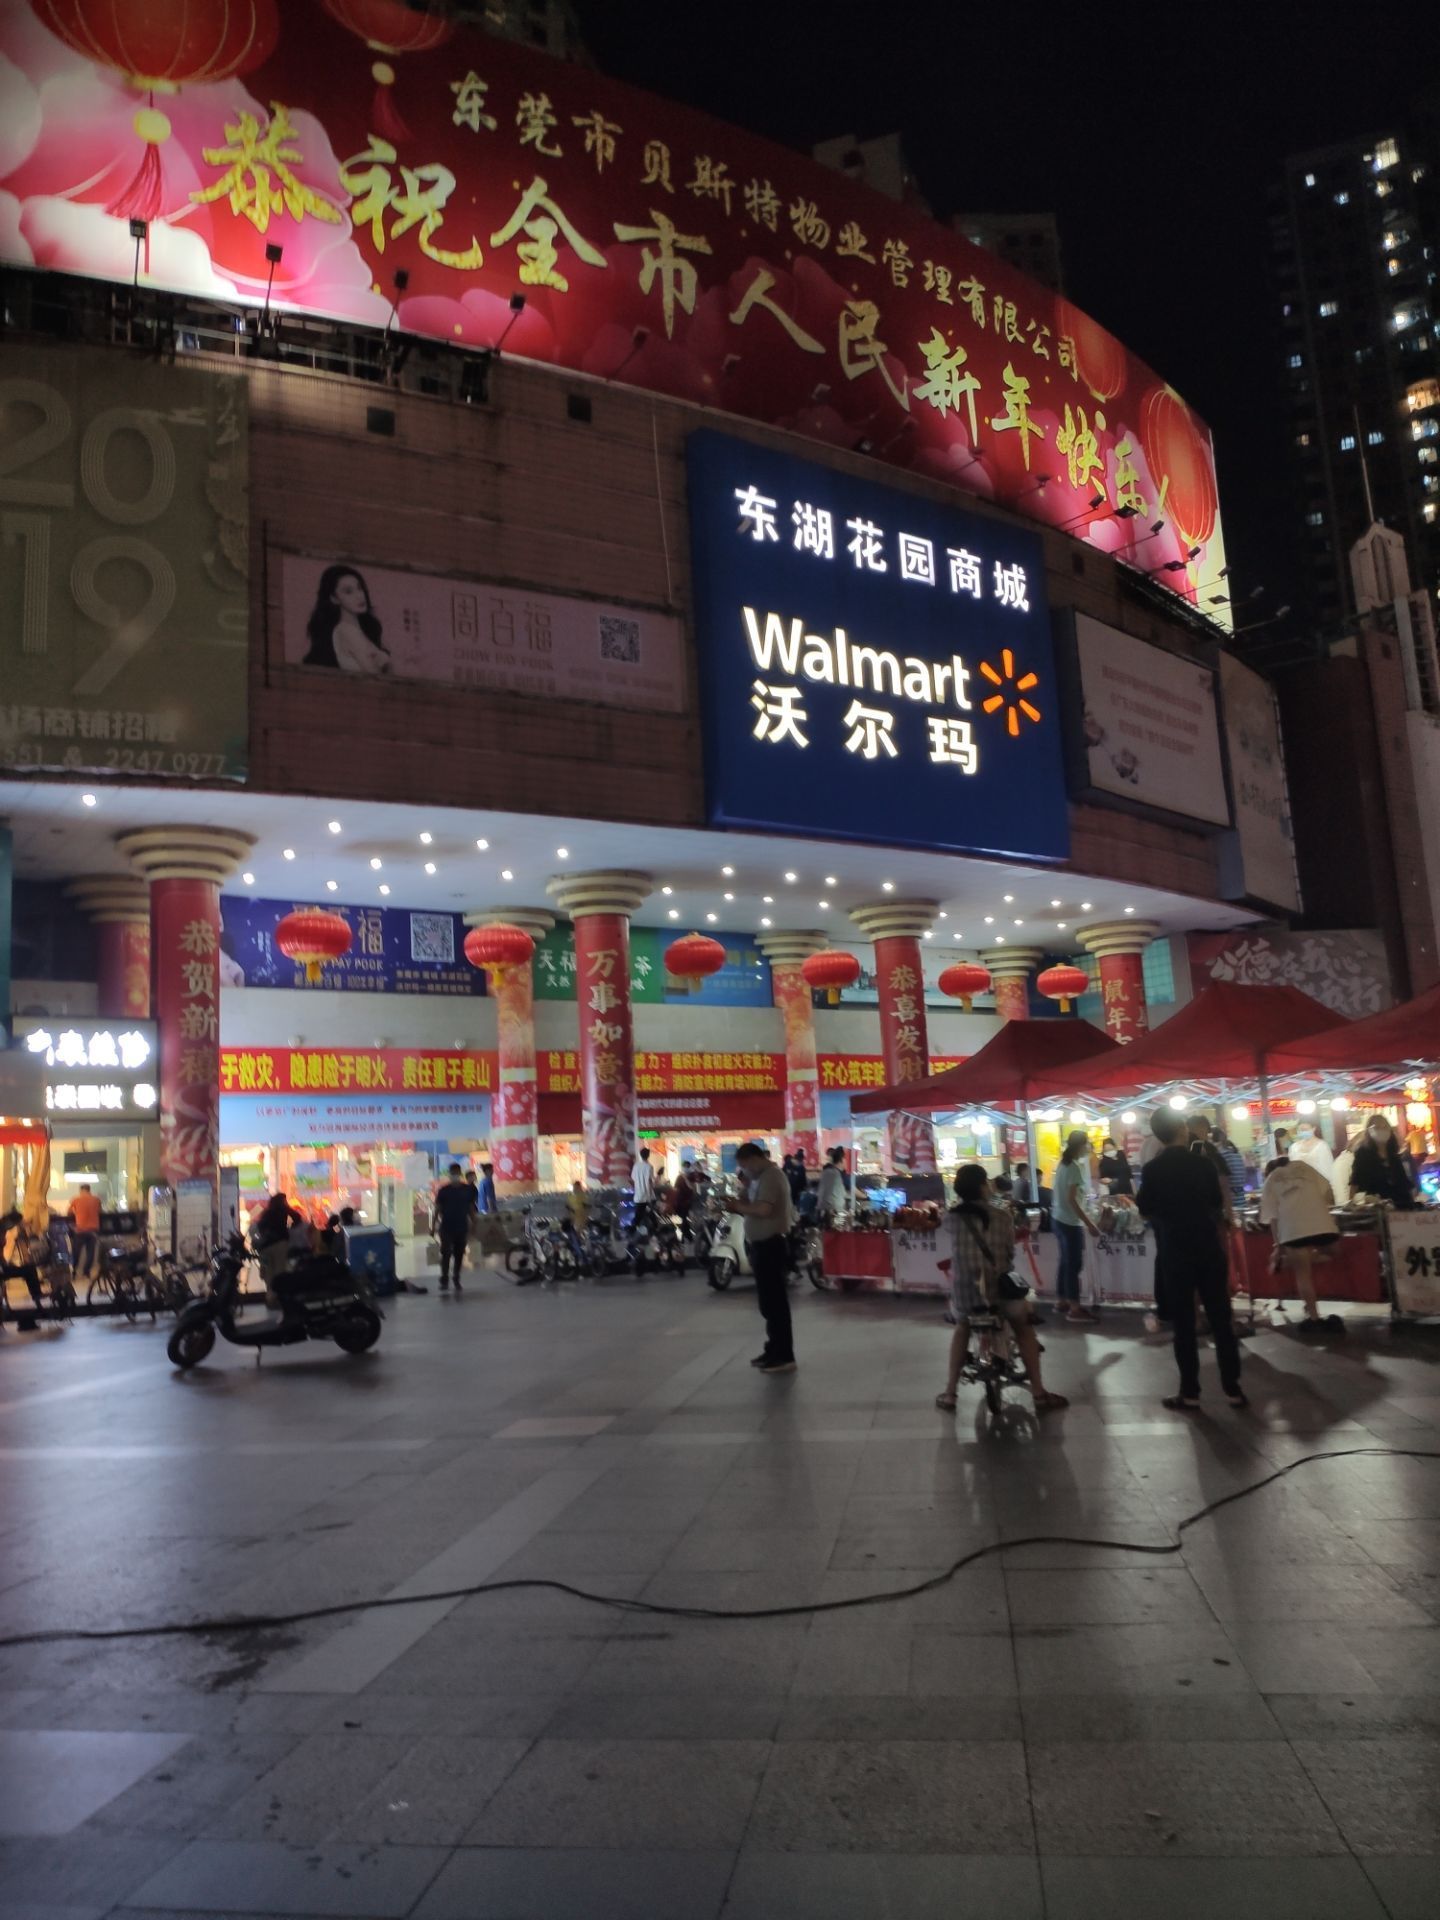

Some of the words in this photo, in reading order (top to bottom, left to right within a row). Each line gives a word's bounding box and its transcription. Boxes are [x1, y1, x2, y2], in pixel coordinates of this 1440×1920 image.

[450, 70, 1079, 382] 东莞市贝斯特物业管理有限公司
[734, 485, 1030, 612] 东湖花园商城
[450, 590, 553, 654] 周百福
[742, 605, 972, 711] Walmart
[750, 679, 978, 776] 沃尔玛
[178, 919, 218, 1083] 恭贺新禧
[586, 949, 623, 1085] 万事如意
[888, 964, 925, 1082] 恭喜发财
